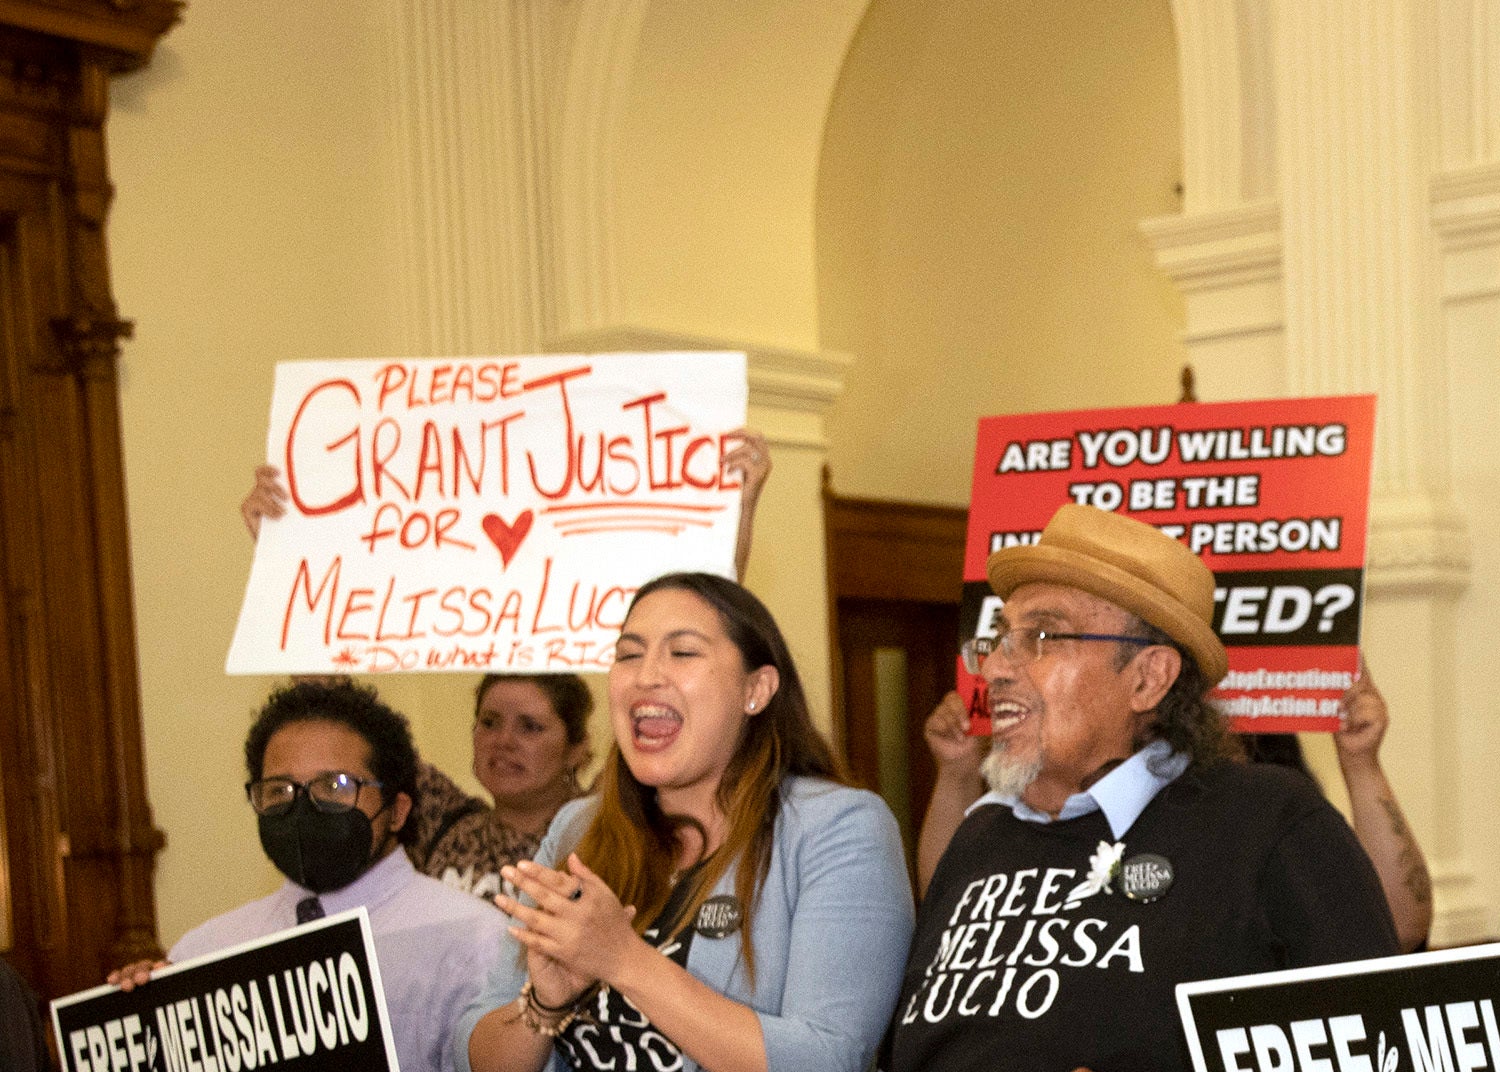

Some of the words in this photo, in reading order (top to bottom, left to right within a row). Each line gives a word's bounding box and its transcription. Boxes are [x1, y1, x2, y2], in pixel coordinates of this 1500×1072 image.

[375, 363, 526, 410] PLEASE
[286, 379, 526, 516] GRANT
[998, 439, 1072, 475] ARE
[1077, 426, 1173, 469] YOU
[1178, 423, 1348, 462] WILLING
[1070, 483, 1124, 512] TO
[1129, 480, 1177, 512] BE
[1183, 475, 1260, 508] THE
[1190, 518, 1342, 555] PERSON
[280, 556, 522, 651] MELISSA
[949, 867, 1076, 926] FREE
[926, 918, 1145, 977] MELISSA
[268, 951, 371, 1062] LUCIO
[902, 968, 1060, 1025] LUCIO
